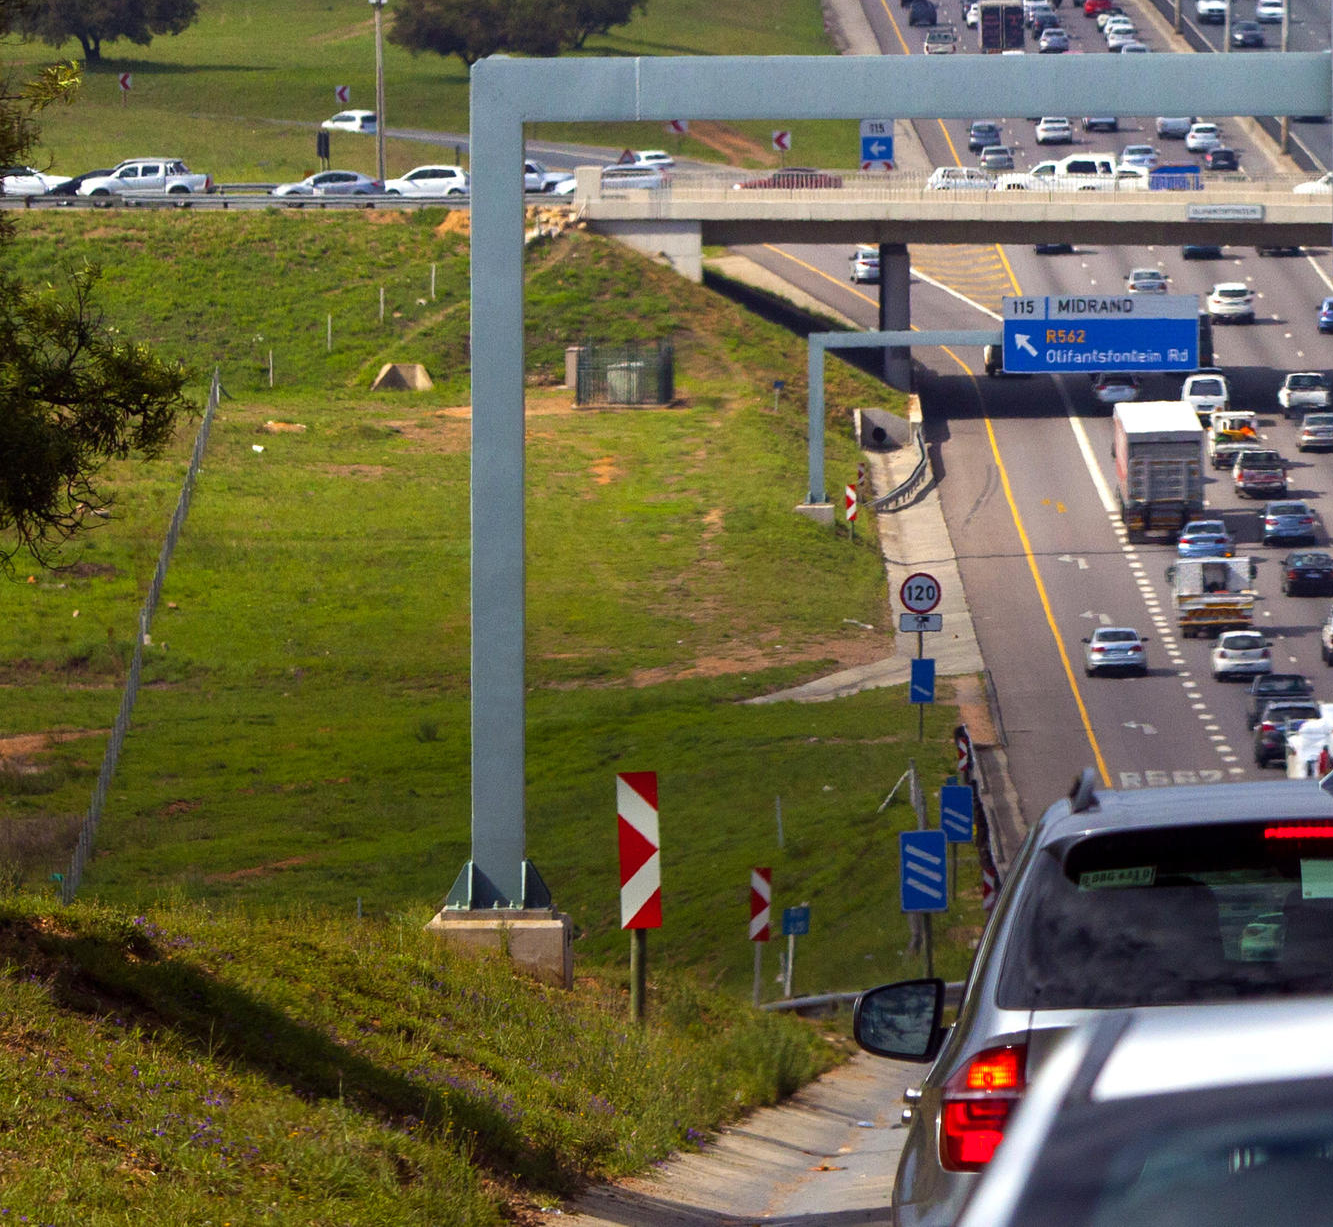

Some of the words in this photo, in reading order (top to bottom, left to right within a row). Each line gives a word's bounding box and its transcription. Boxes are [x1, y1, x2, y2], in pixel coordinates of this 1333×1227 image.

[1013, 301, 1034, 314] 115
[1058, 299, 1134, 313] MIDRAND
[1046, 330, 1086, 343] R562
[1046, 349, 1162, 363] Olifantsfontein
[1167, 349, 1189, 362] Rd
[906, 585, 936, 601] 120
